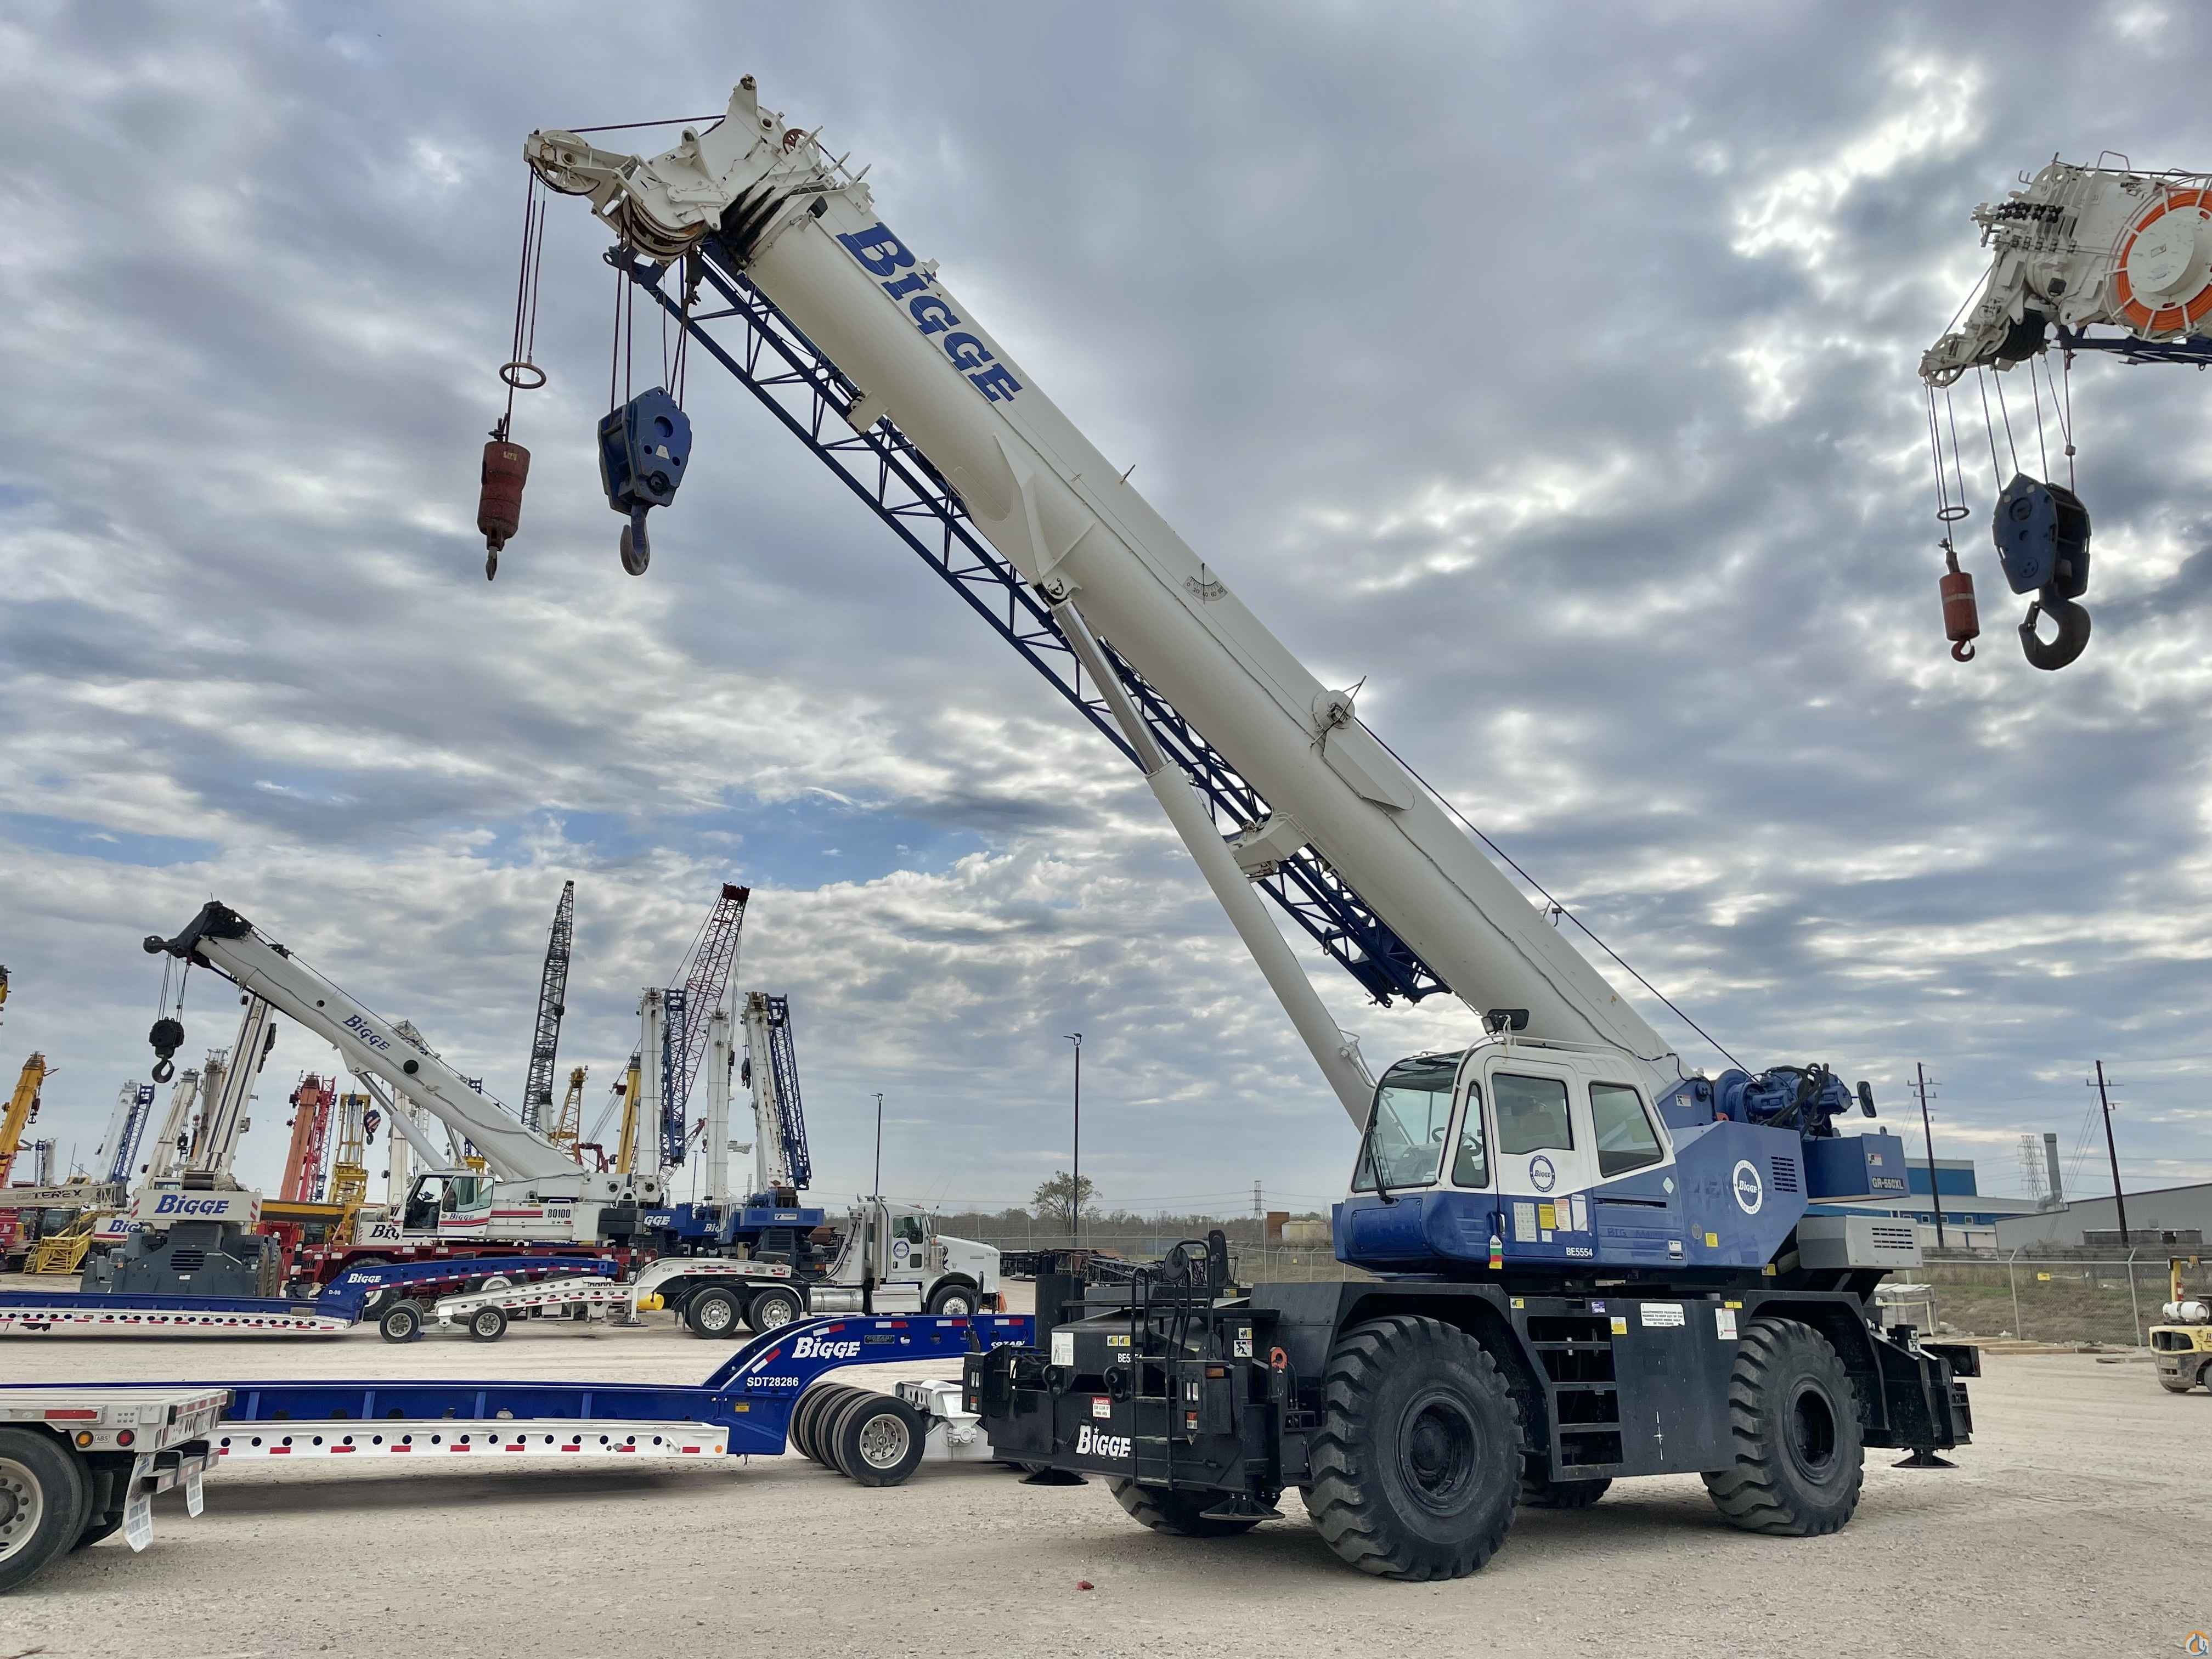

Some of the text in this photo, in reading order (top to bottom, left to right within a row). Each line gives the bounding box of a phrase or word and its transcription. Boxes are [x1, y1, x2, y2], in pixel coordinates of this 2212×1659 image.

[835, 222, 1023, 403] BIGGE
[342, 1014, 391, 1050] BIGGE
[1738, 1180, 1758, 1193] BIGGE
[1872, 1177, 1904, 1190] GR-550XL
[35, 1189, 82, 1199] TEREX
[155, 1194, 229, 1215] BIGGE
[548, 1209, 571, 1218] 80100
[1566, 1246, 1593, 1257] BE5554
[347, 1273, 382, 1284] BIGGE
[792, 1336, 860, 1358] BIGGE
[747, 1377, 799, 1387] SDT28286
[1076, 1425, 1131, 1457] BIGGE
